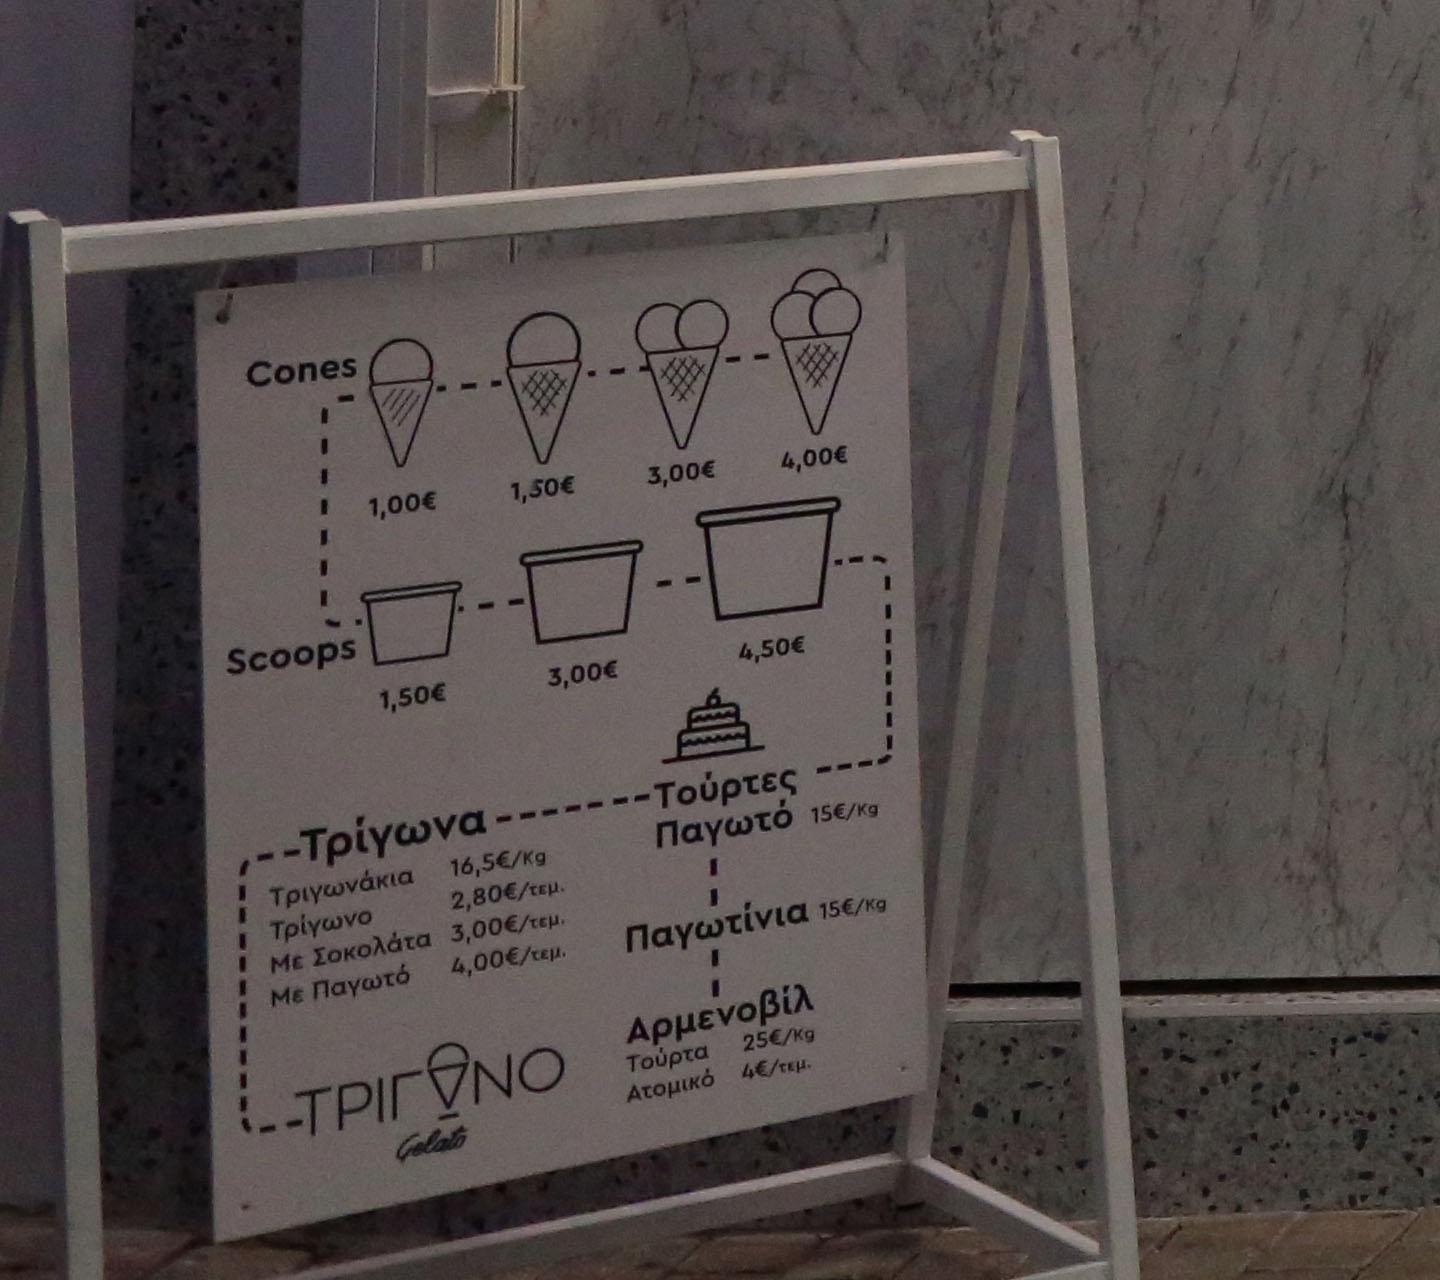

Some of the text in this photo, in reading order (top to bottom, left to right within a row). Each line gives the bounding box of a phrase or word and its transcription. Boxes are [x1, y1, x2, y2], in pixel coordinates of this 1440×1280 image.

[247, 357, 358, 387] Cones
[647, 460, 716, 489] 3,00€
[781, 444, 848, 473] 4,00€
[368, 491, 438, 521] 1,00€
[510, 475, 576, 505] 1,50€
[226, 639, 357, 676] Scoops
[738, 635, 806, 664] 4,50€
[547, 660, 618, 690] 3,00€
[379, 682, 447, 714] 1,50€
[654, 769, 798, 810] Τούρτες
[299, 809, 488, 867] Τρίγωνα
[656, 798, 793, 849] Παγωτό
[270, 868, 415, 909] Τριγωνάκια
[270, 908, 373, 942] Τρίγωνο
[626, 902, 810, 954] Παγωτίνια
[270, 953, 304, 974] Με
[312, 930, 433, 968] Σοκολάτα
[270, 987, 305, 1009] Με
[312, 963, 411, 1001] Παγωτό
[626, 983, 815, 1046] Αρμενοβίλ
[626, 1044, 710, 1073] Τούρτα
[626, 1067, 715, 1104] Ατομικό
[396, 1124, 469, 1163] Gelato
